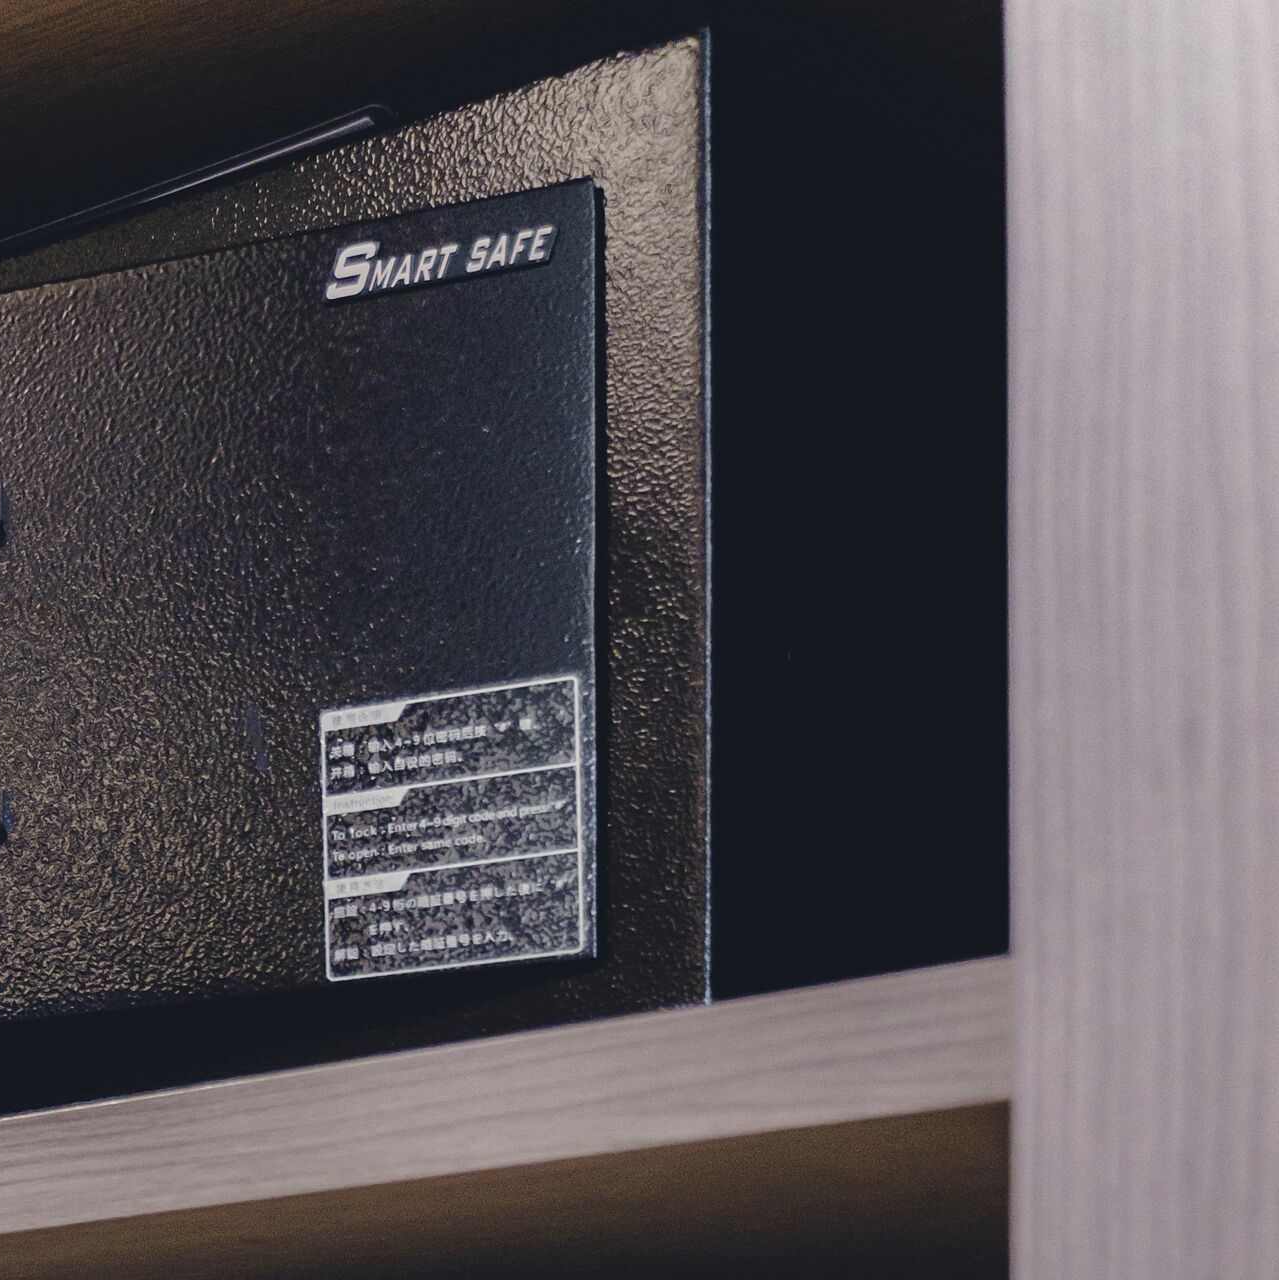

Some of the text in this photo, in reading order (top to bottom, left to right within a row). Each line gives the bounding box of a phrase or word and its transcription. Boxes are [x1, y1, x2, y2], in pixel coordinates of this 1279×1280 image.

[326, 226, 554, 301] SMART SAFE
[387, 821, 417, 833] Enter
[468, 810, 495, 822] code
[496, 806, 517, 819] and
[387, 844, 417, 855] Enter
[421, 839, 451, 850] same
